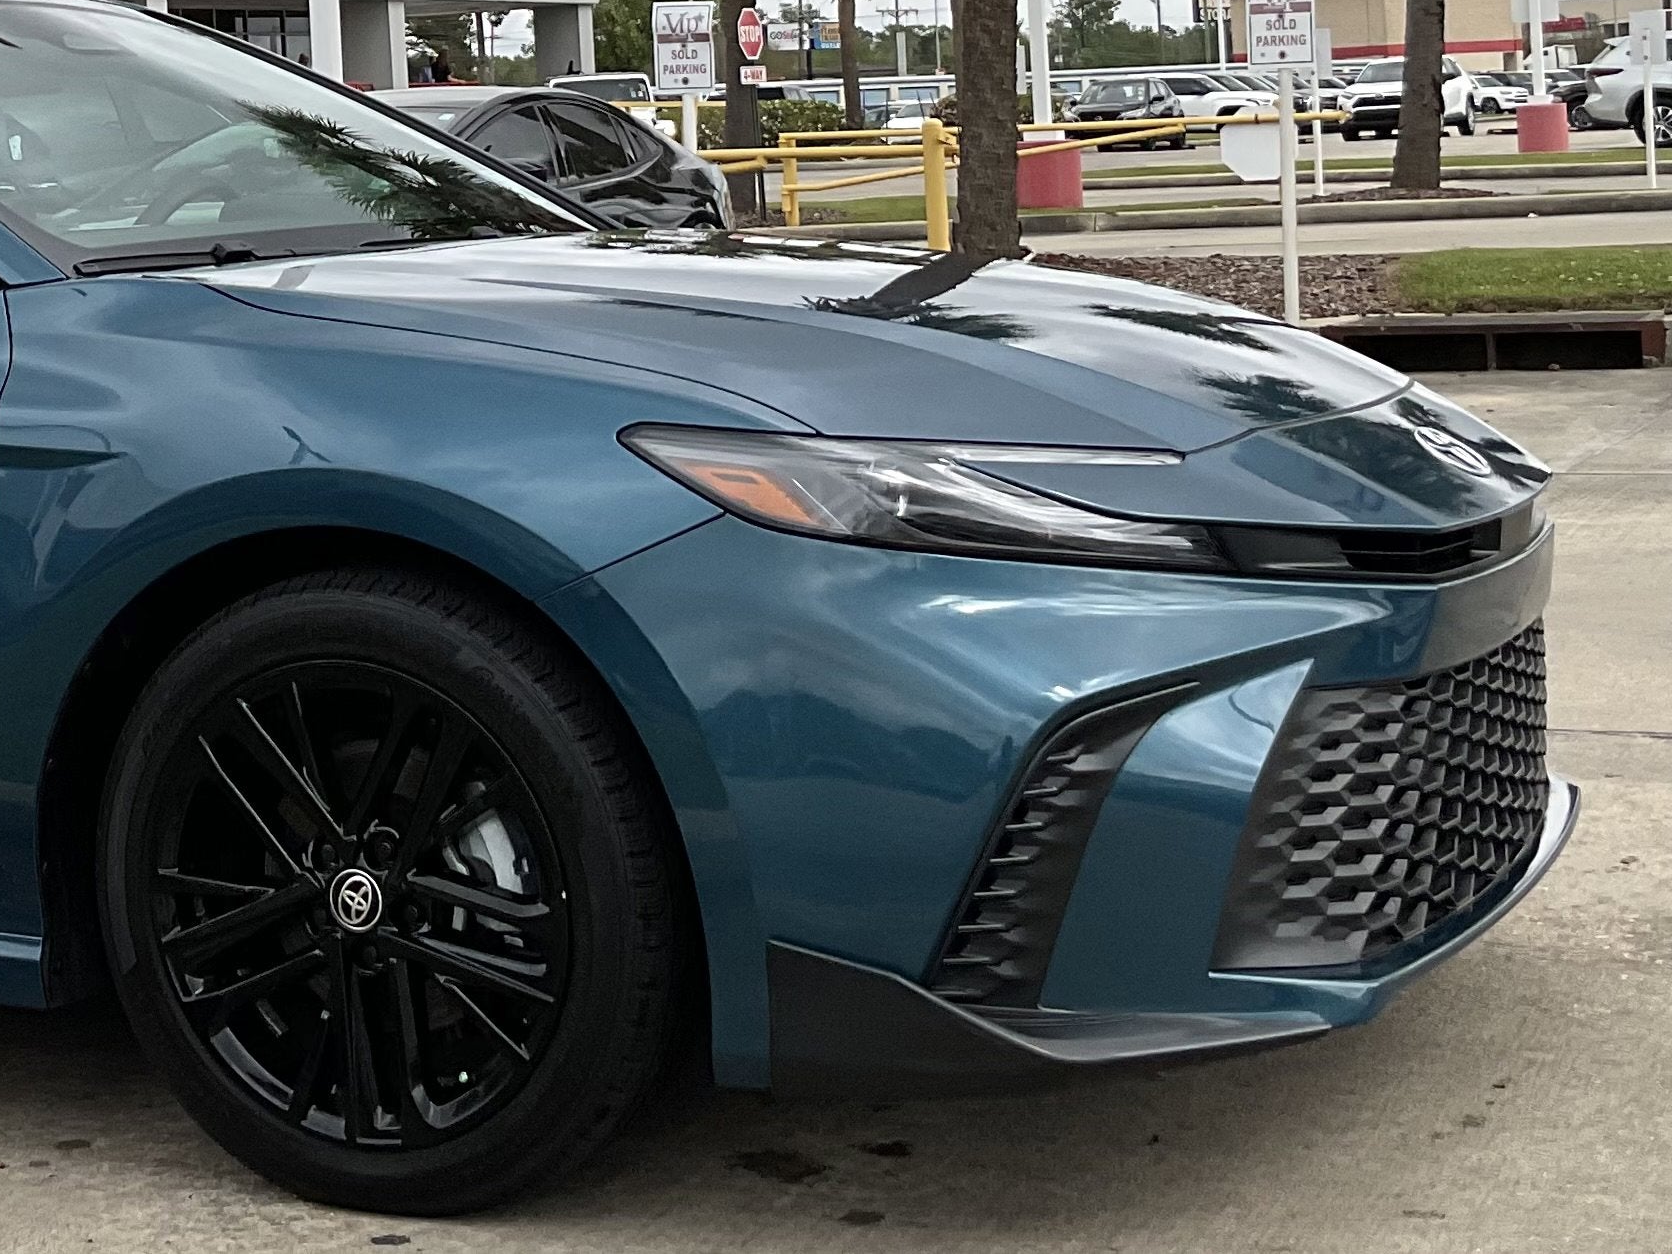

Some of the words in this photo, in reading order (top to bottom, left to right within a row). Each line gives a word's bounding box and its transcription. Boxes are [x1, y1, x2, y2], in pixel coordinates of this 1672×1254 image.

[1265, 18, 1297, 31] SOLD
[740, 26, 760, 43] STOP
[1255, 34, 1307, 47] PARKING
[671, 49, 698, 60] SOLD
[663, 64, 707, 75] PARKING
[744, 69, 763, 81] 4-WAY
